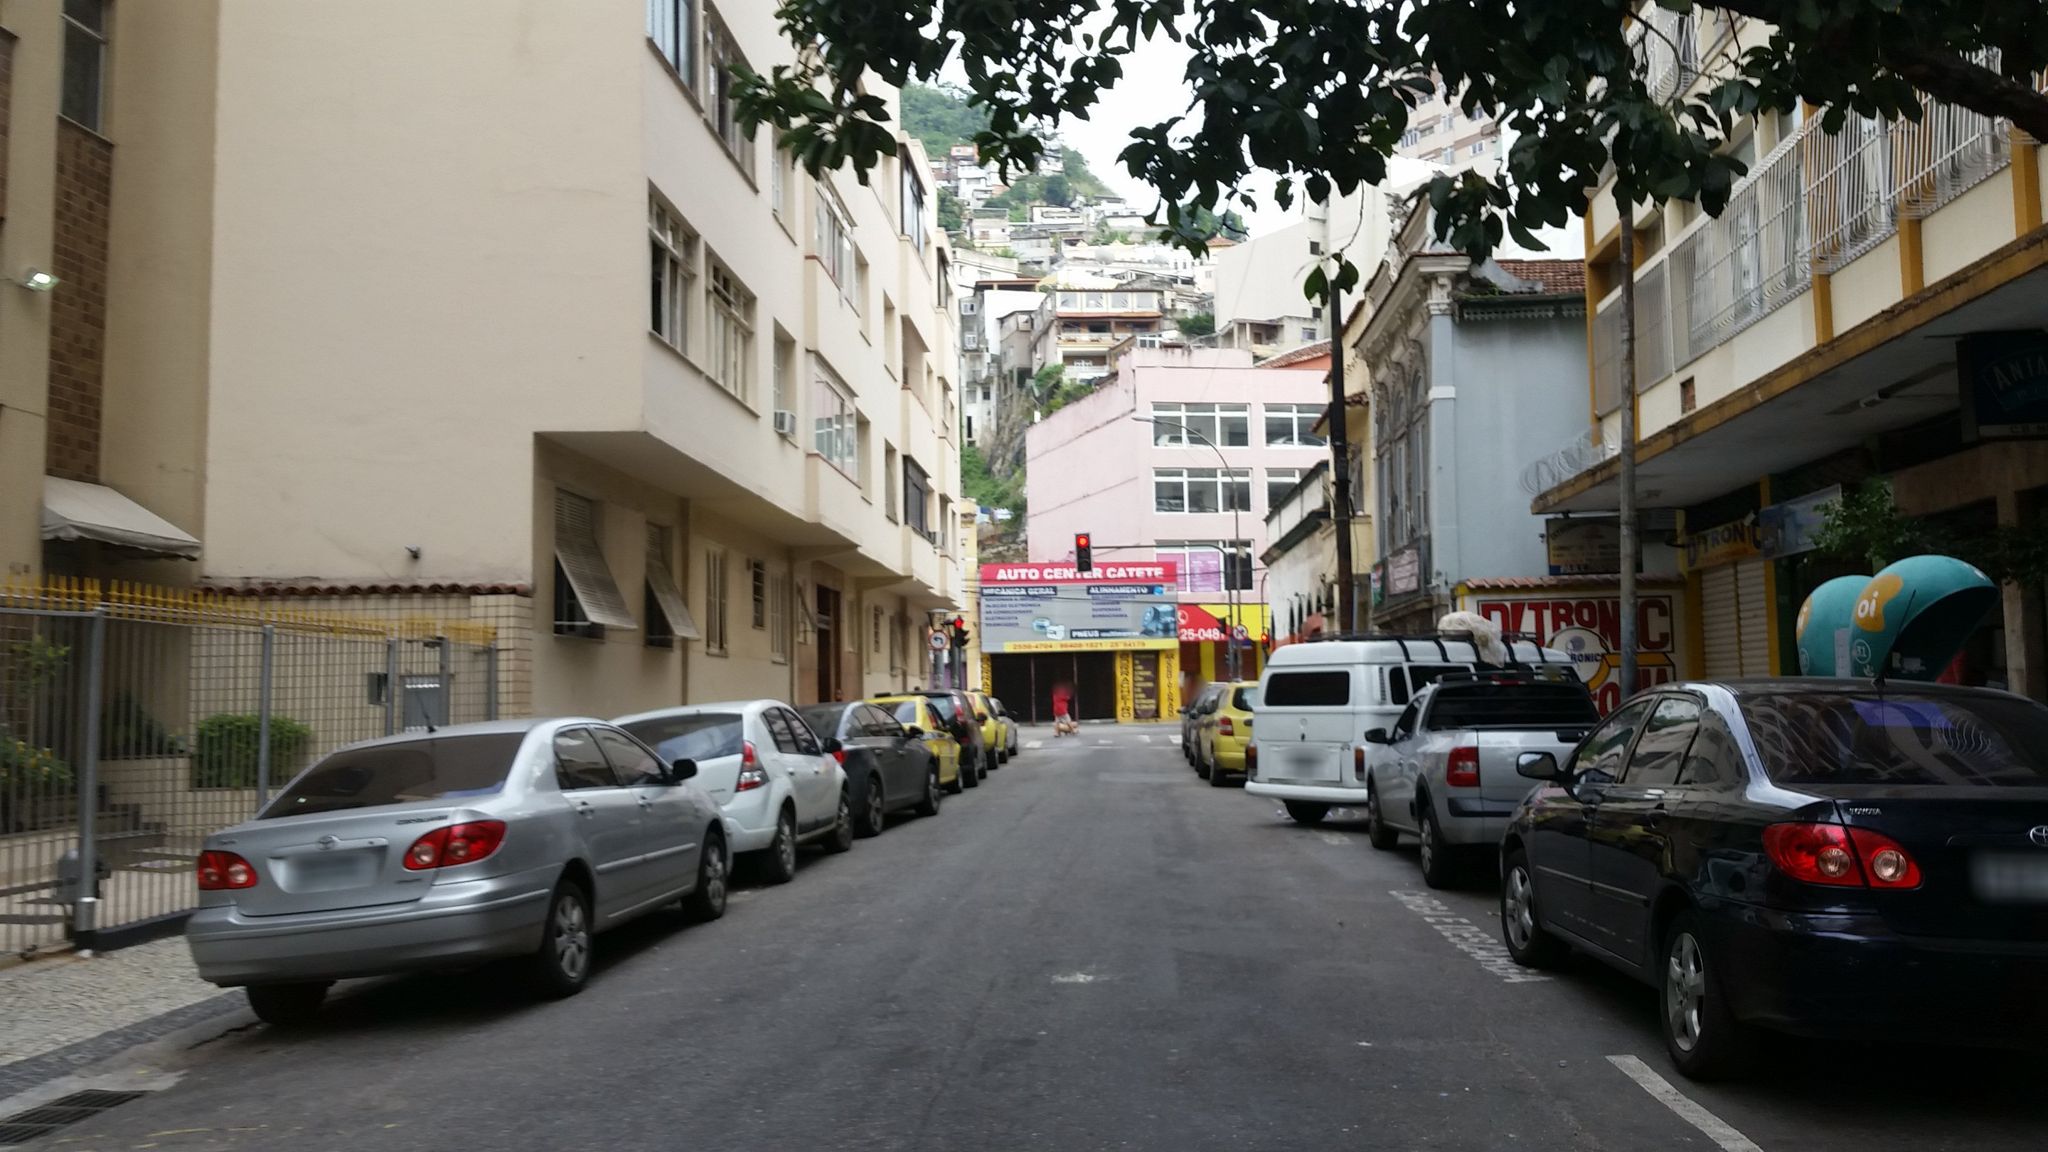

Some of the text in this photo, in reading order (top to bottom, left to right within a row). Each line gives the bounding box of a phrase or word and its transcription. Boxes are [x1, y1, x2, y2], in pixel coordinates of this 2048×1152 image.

[997, 568, 1040, 581] AUTO
[1106, 567, 1165, 579] CATETE
[1857, 590, 1879, 619] oi
[1481, 599, 1670, 650] DITRONC
[1072, 630, 1100, 638] PNEUS
[1571, 652, 1602, 663] RONIC
